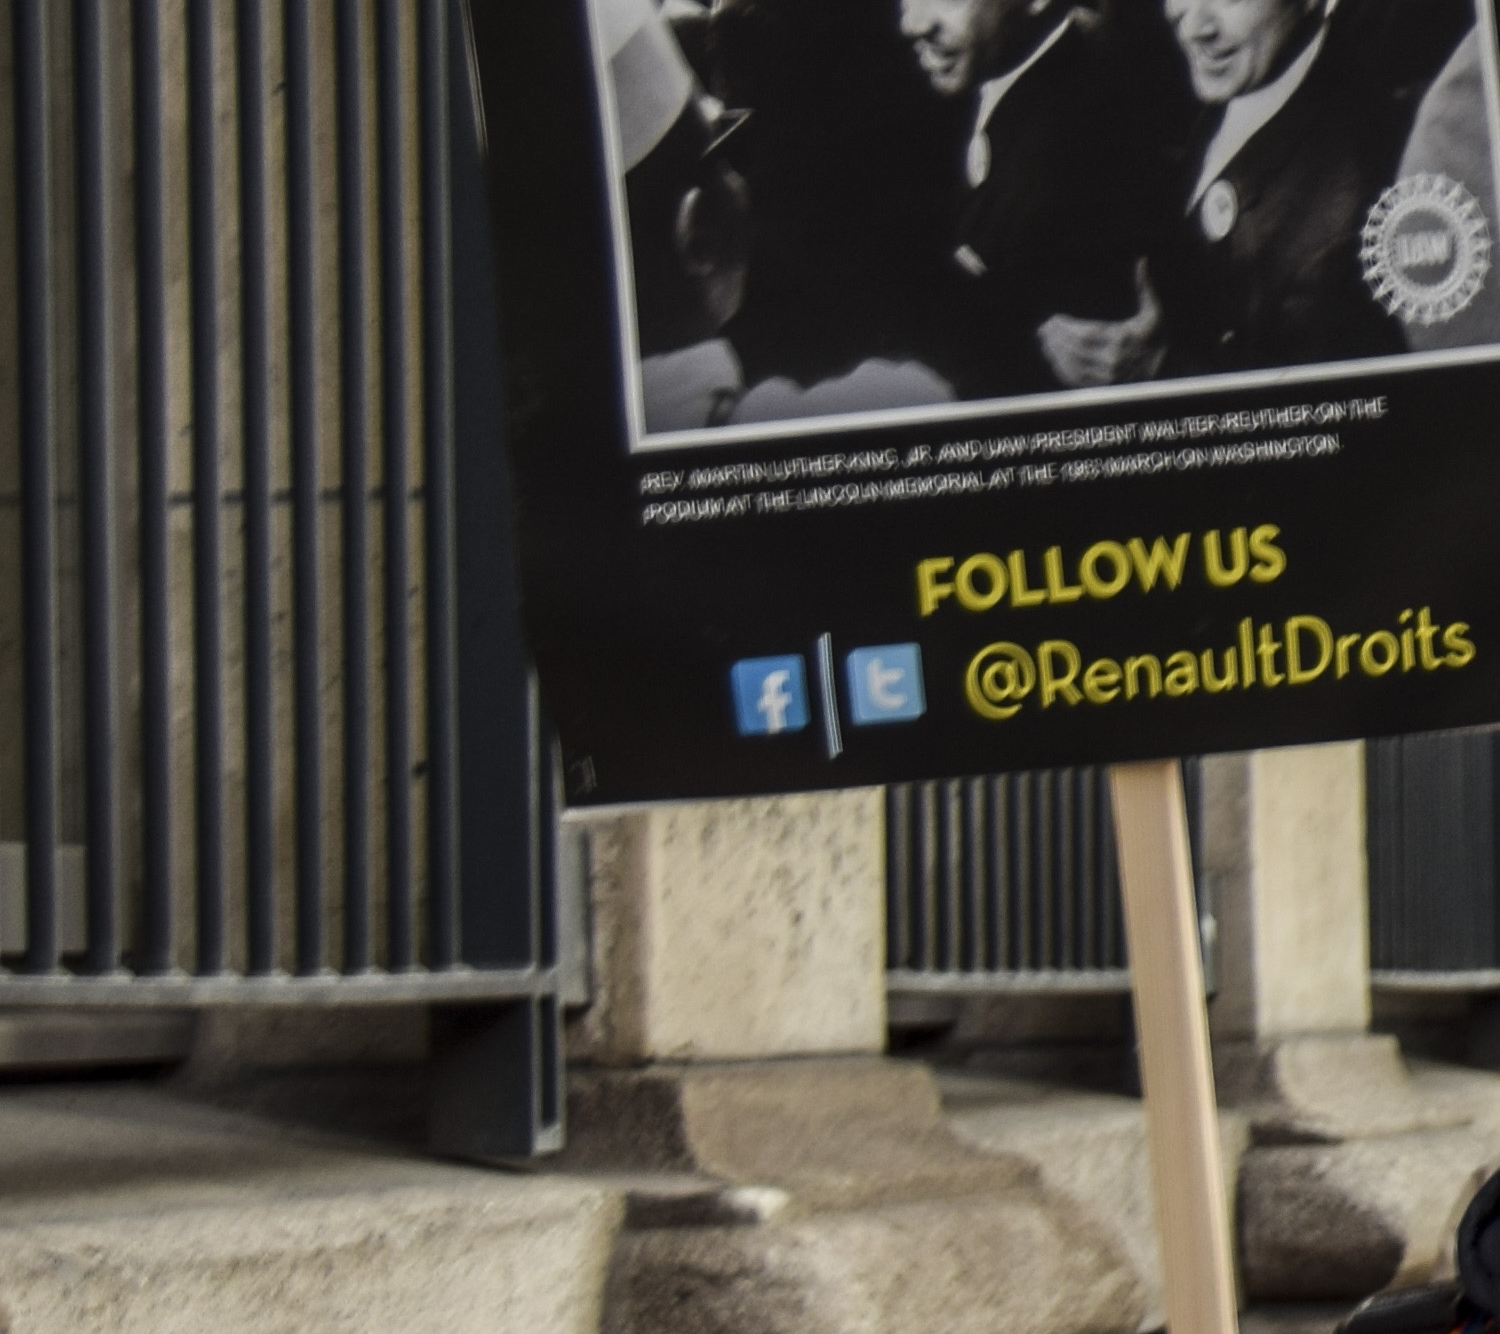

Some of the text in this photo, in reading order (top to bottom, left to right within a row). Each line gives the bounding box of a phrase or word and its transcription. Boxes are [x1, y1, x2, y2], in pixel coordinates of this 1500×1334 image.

[916, 523, 1287, 617] FOLLOW US
[964, 603, 1477, 721] @RenaultDroits
